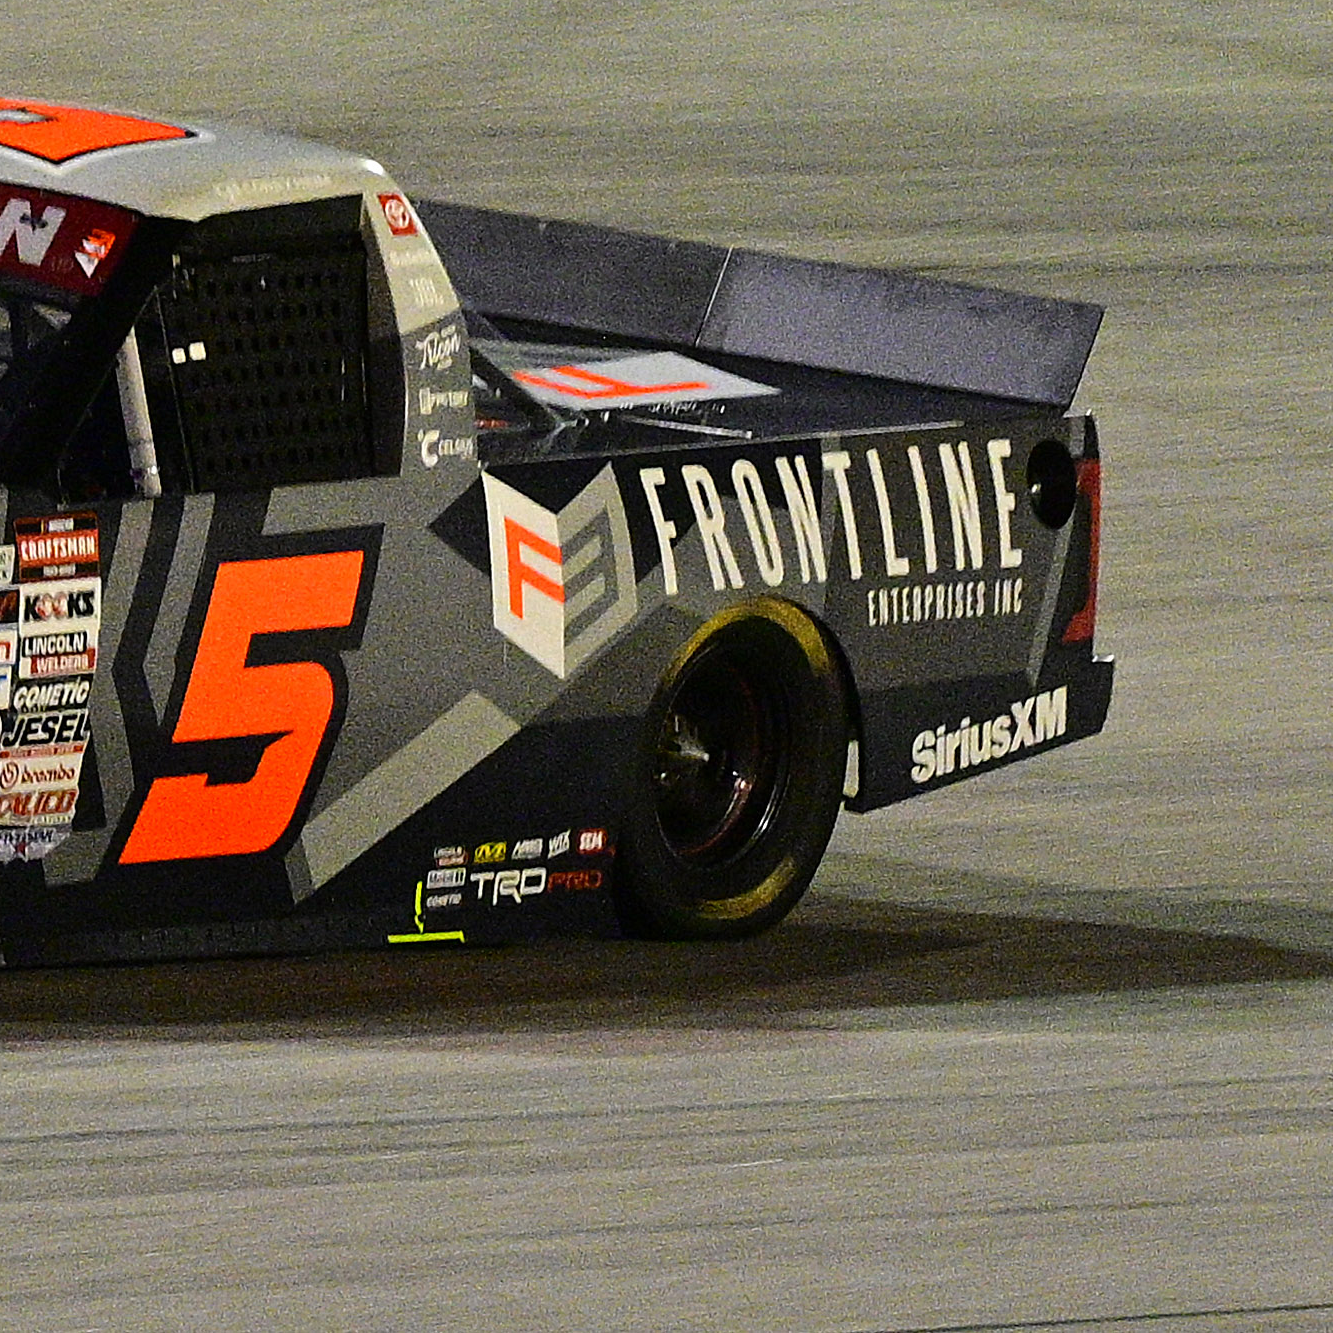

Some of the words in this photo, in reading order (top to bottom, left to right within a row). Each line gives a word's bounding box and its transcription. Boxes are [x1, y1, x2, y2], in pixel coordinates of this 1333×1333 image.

[640, 438, 1023, 596] FRONTLINE
[21, 536, 96, 561] CRAFTSMAN
[25, 592, 95, 620] KOOKS
[867, 584, 985, 627] ENTERPRISES
[994, 578, 1023, 616] INC
[25, 633, 86, 656] LINCOLN
[118, 550, 364, 865] 5
[3, 713, 90, 746] JESEL
[911, 686, 1068, 784] SiriusXM
[21, 763, 75, 784] brembo
[470, 867, 547, 906] TRD
